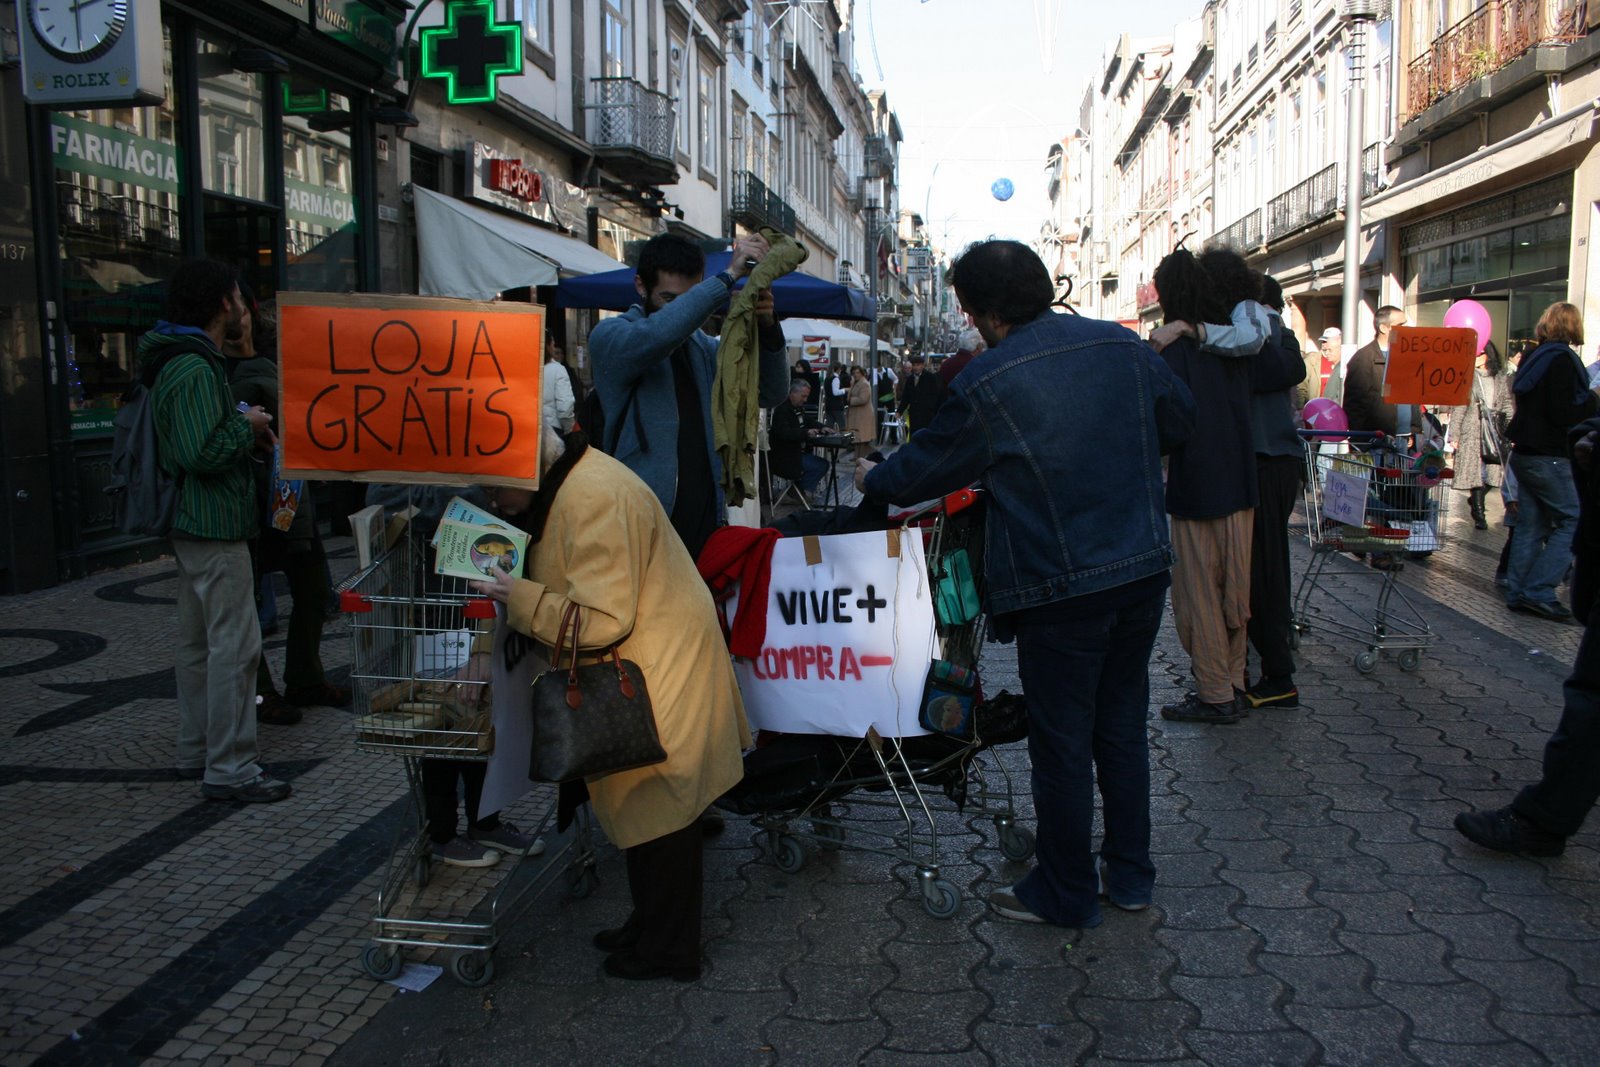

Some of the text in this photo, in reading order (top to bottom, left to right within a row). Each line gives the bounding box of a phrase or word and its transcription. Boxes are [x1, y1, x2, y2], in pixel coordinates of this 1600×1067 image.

[53, 72, 111, 89] ROLEX
[51, 123, 179, 183] FARMÁCIA
[1, 243, 27, 262] 137
[328, 319, 506, 385] LOJA
[1415, 361, 1470, 397] 100%
